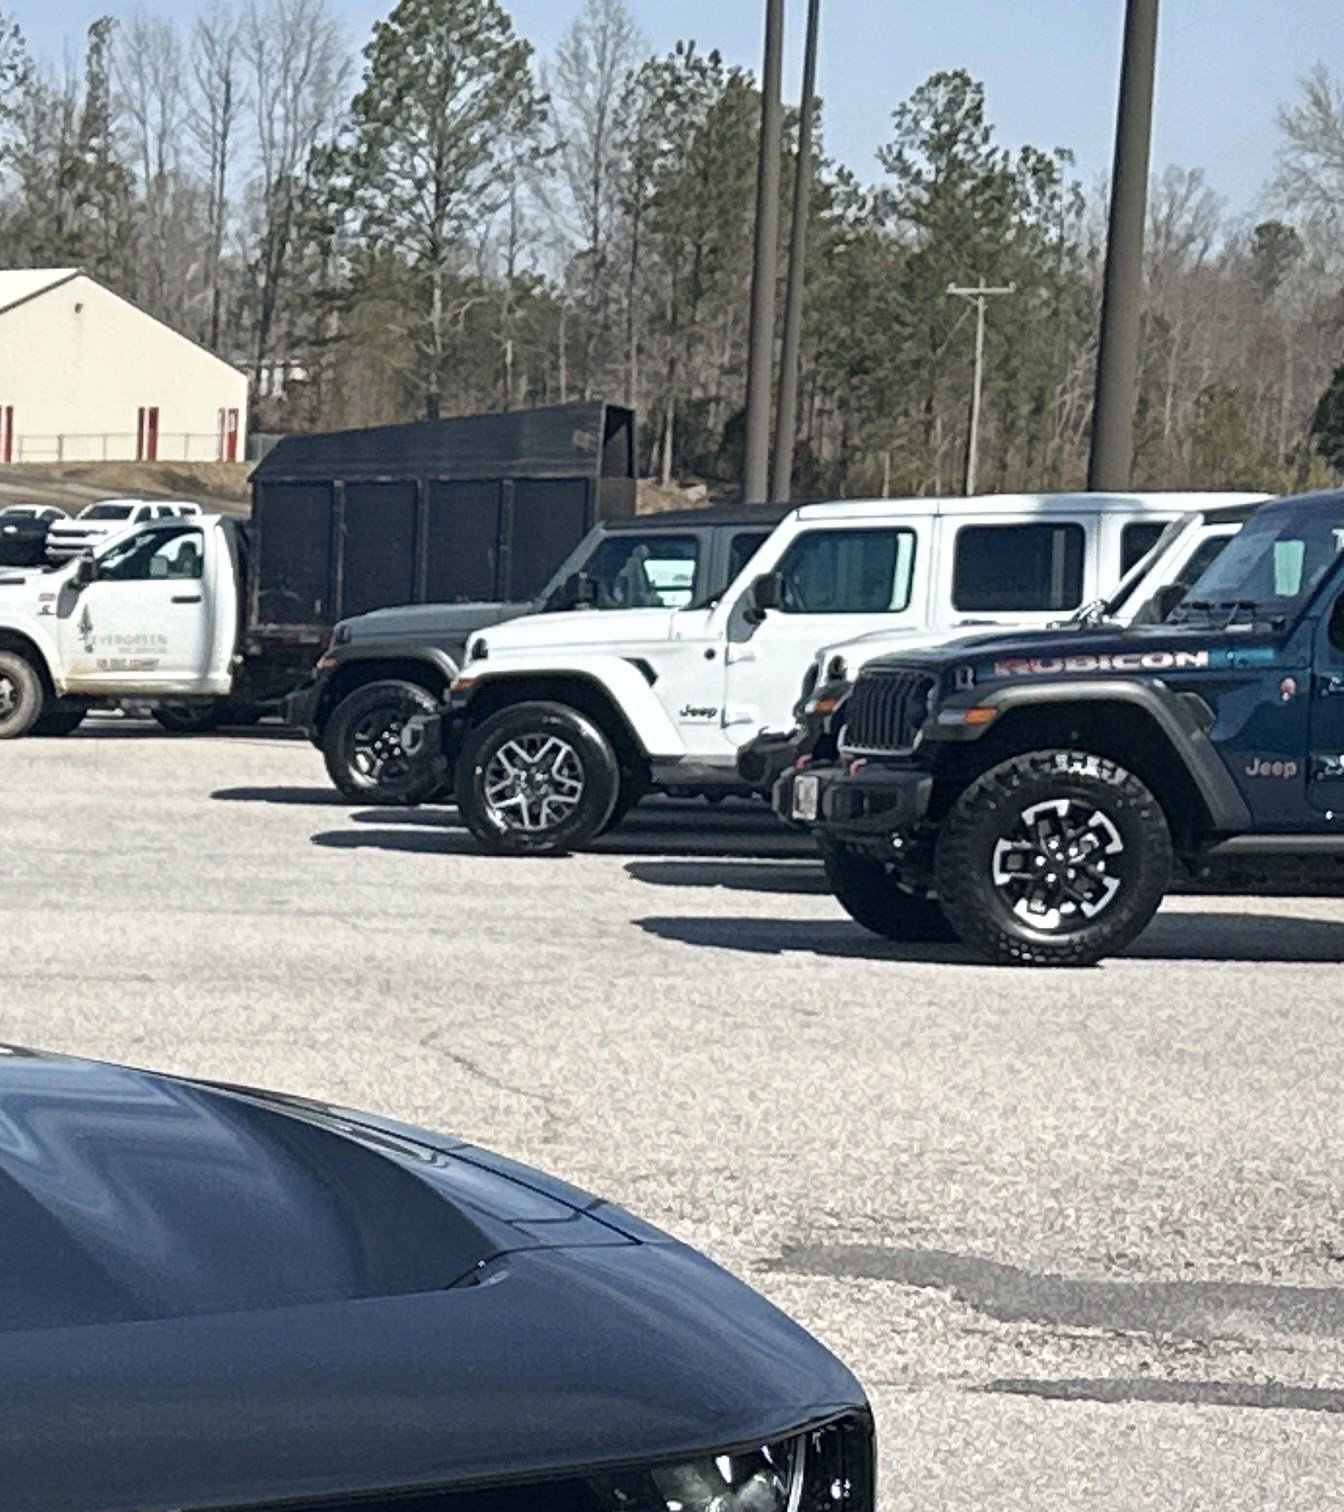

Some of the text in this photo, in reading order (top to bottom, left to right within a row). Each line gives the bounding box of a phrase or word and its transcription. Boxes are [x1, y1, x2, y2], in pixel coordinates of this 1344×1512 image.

[993, 650, 1209, 676] RUBICON
[679, 703, 718, 719] Jeep
[1245, 757, 1297, 779] Jeep
